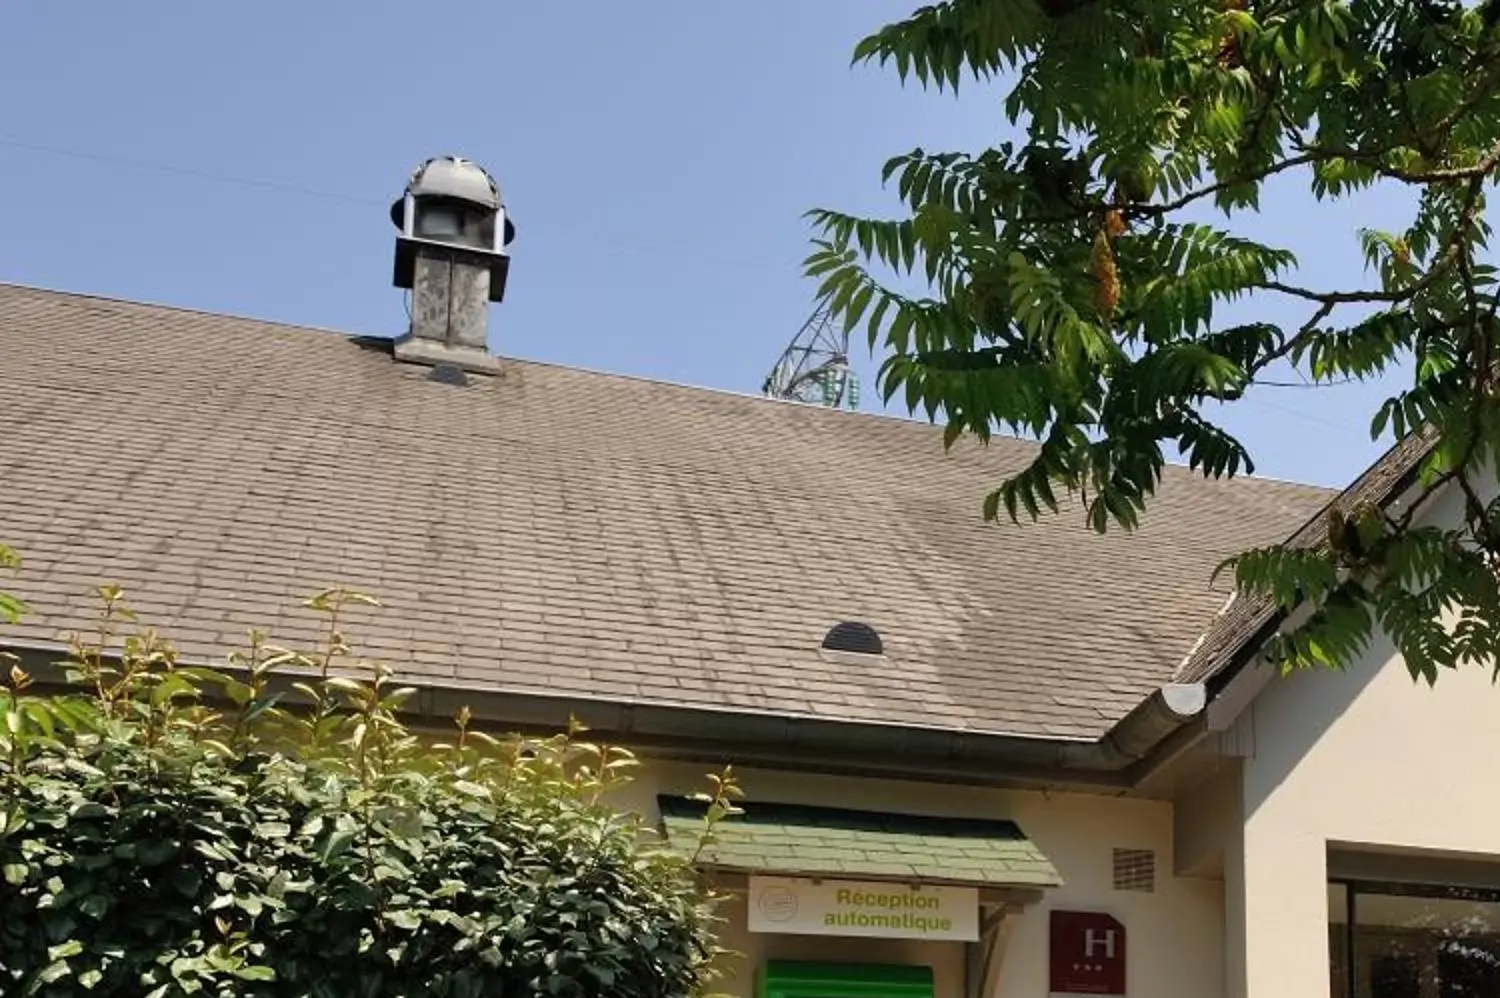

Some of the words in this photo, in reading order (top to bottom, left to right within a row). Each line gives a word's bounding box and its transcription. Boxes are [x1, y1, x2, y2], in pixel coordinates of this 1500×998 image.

[836, 888, 940, 911] Réception
[823, 911, 953, 933] automatique
[1085, 928, 1115, 959] H
